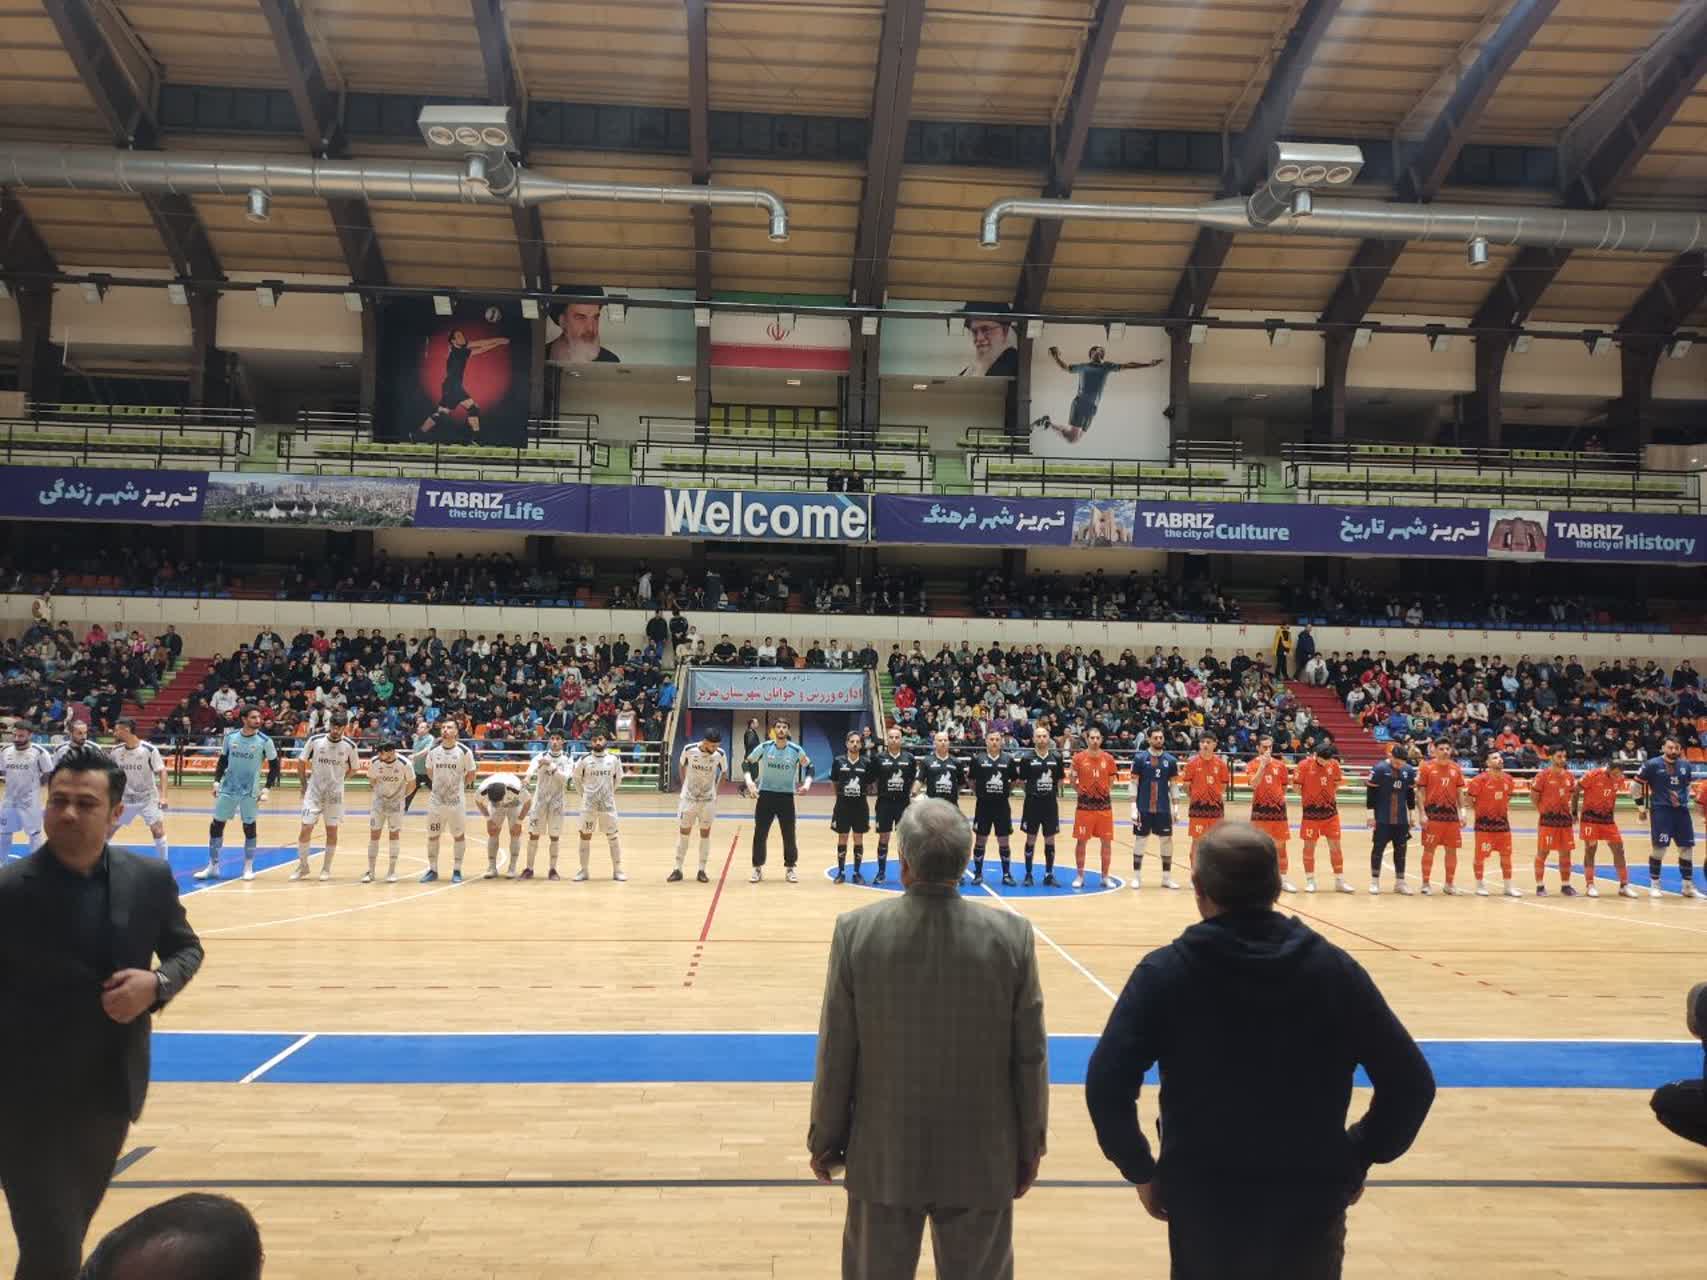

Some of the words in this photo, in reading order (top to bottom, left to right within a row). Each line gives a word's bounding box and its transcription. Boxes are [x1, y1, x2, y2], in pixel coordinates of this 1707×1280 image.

[39, 478, 92, 506] زندگی
[96, 481, 140, 506] شهر
[142, 486, 198, 508] تبریز
[426, 490, 504, 508] TABRIZ
[449, 508, 468, 518] the
[468, 508, 489, 520] city
[490, 509, 502, 520] of
[504, 501, 544, 521] Life
[664, 488, 867, 538] Welcome
[922, 504, 976, 530] فرهنگ
[978, 506, 1014, 530] شهر
[1016, 510, 1065, 532] تبریز
[1142, 512, 1215, 529] TABRIZ
[1164, 528, 1182, 538] the
[1183, 529, 1202, 540] city
[1204, 530, 1214, 538] of
[1216, 523, 1290, 541] Culture
[1340, 516, 1385, 542] تاریخ
[1388, 517, 1428, 540] شهر
[1430, 521, 1480, 542] تبریز
[1554, 522, 1624, 540] TABRIZ
[1576, 540, 1592, 549] the
[1594, 540, 1612, 551] city
[1613, 541, 1624, 549] of
[1625, 533, 1696, 554] History
[1155, 768, 1161, 778] 2
